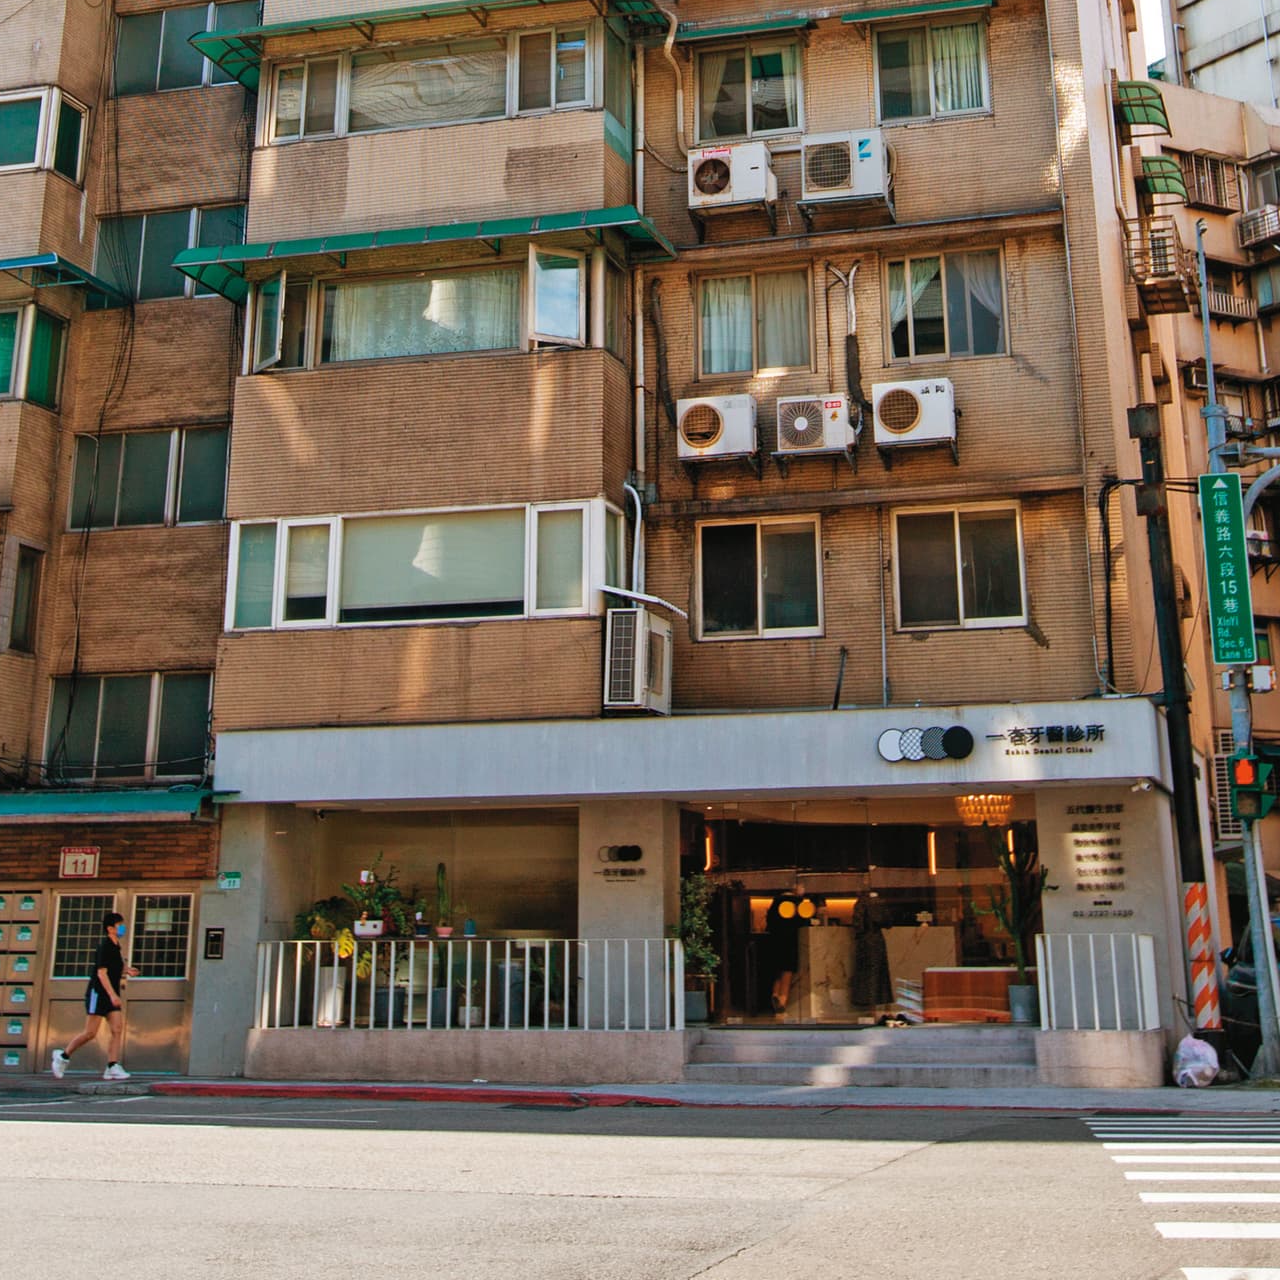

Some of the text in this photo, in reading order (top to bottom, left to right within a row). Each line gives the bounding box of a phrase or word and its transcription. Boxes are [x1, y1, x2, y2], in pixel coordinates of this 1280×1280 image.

[1213, 492, 1239, 613] 信義路六段15巷
[1239, 636, 1245, 648] 6
[1220, 647, 1253, 659] Lane 15
[1033, 746, 1063, 755] Dental
[1066, 746, 1093, 754] Clinic
[72, 858, 88, 873] 11
